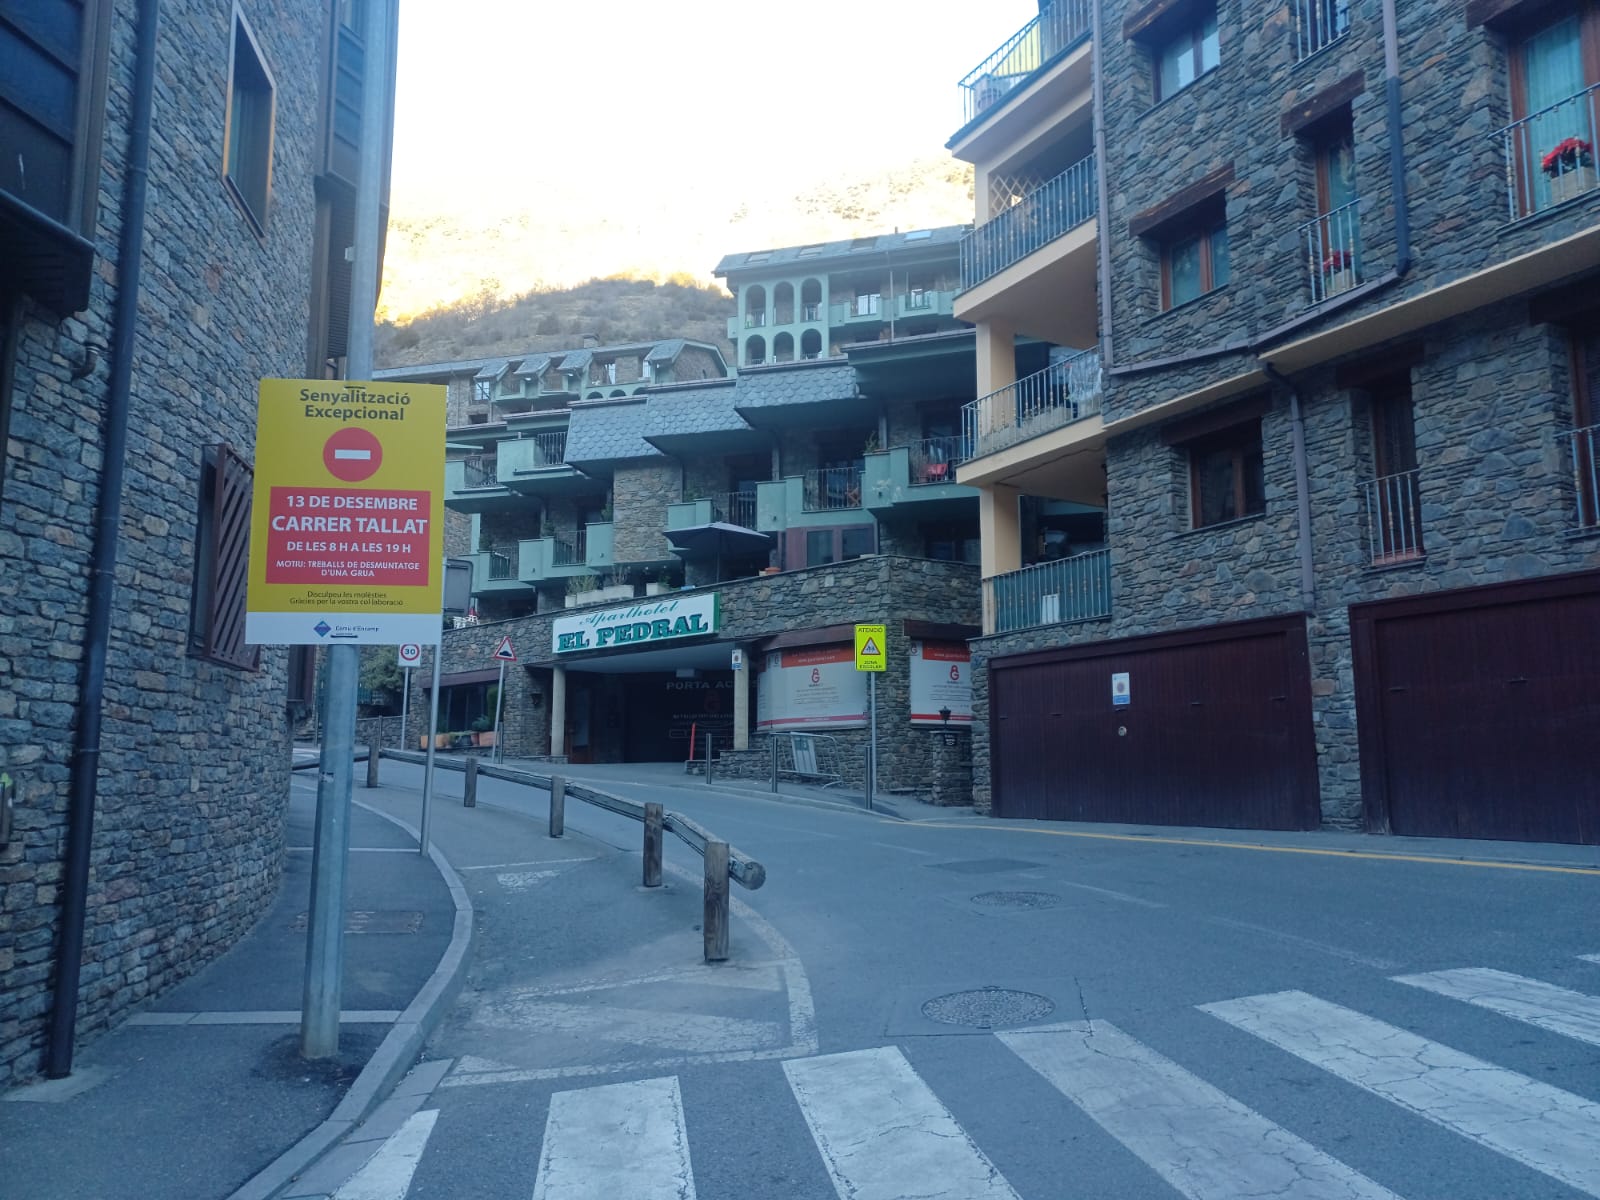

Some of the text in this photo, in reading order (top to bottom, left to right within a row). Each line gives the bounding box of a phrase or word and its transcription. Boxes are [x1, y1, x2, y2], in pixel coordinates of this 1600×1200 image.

[300, 389, 410, 405] Senyalització
[305, 405, 404, 421] Excepcional
[287, 496, 417, 510] 13 DE DESEMBRE
[272, 516, 428, 534] CARRER TALLAT
[287, 541, 411, 553] DE LES 8 H A LES 19 H
[276, 560, 420, 570] MOTIU: TREBALLS DE DESMUNTATGE
[321, 569, 375, 577] D'UNA GRUA
[579, 601, 679, 627] Aparthotel
[558, 614, 708, 651] EL PEDRAL
[666, 680, 710, 690] PORTA
